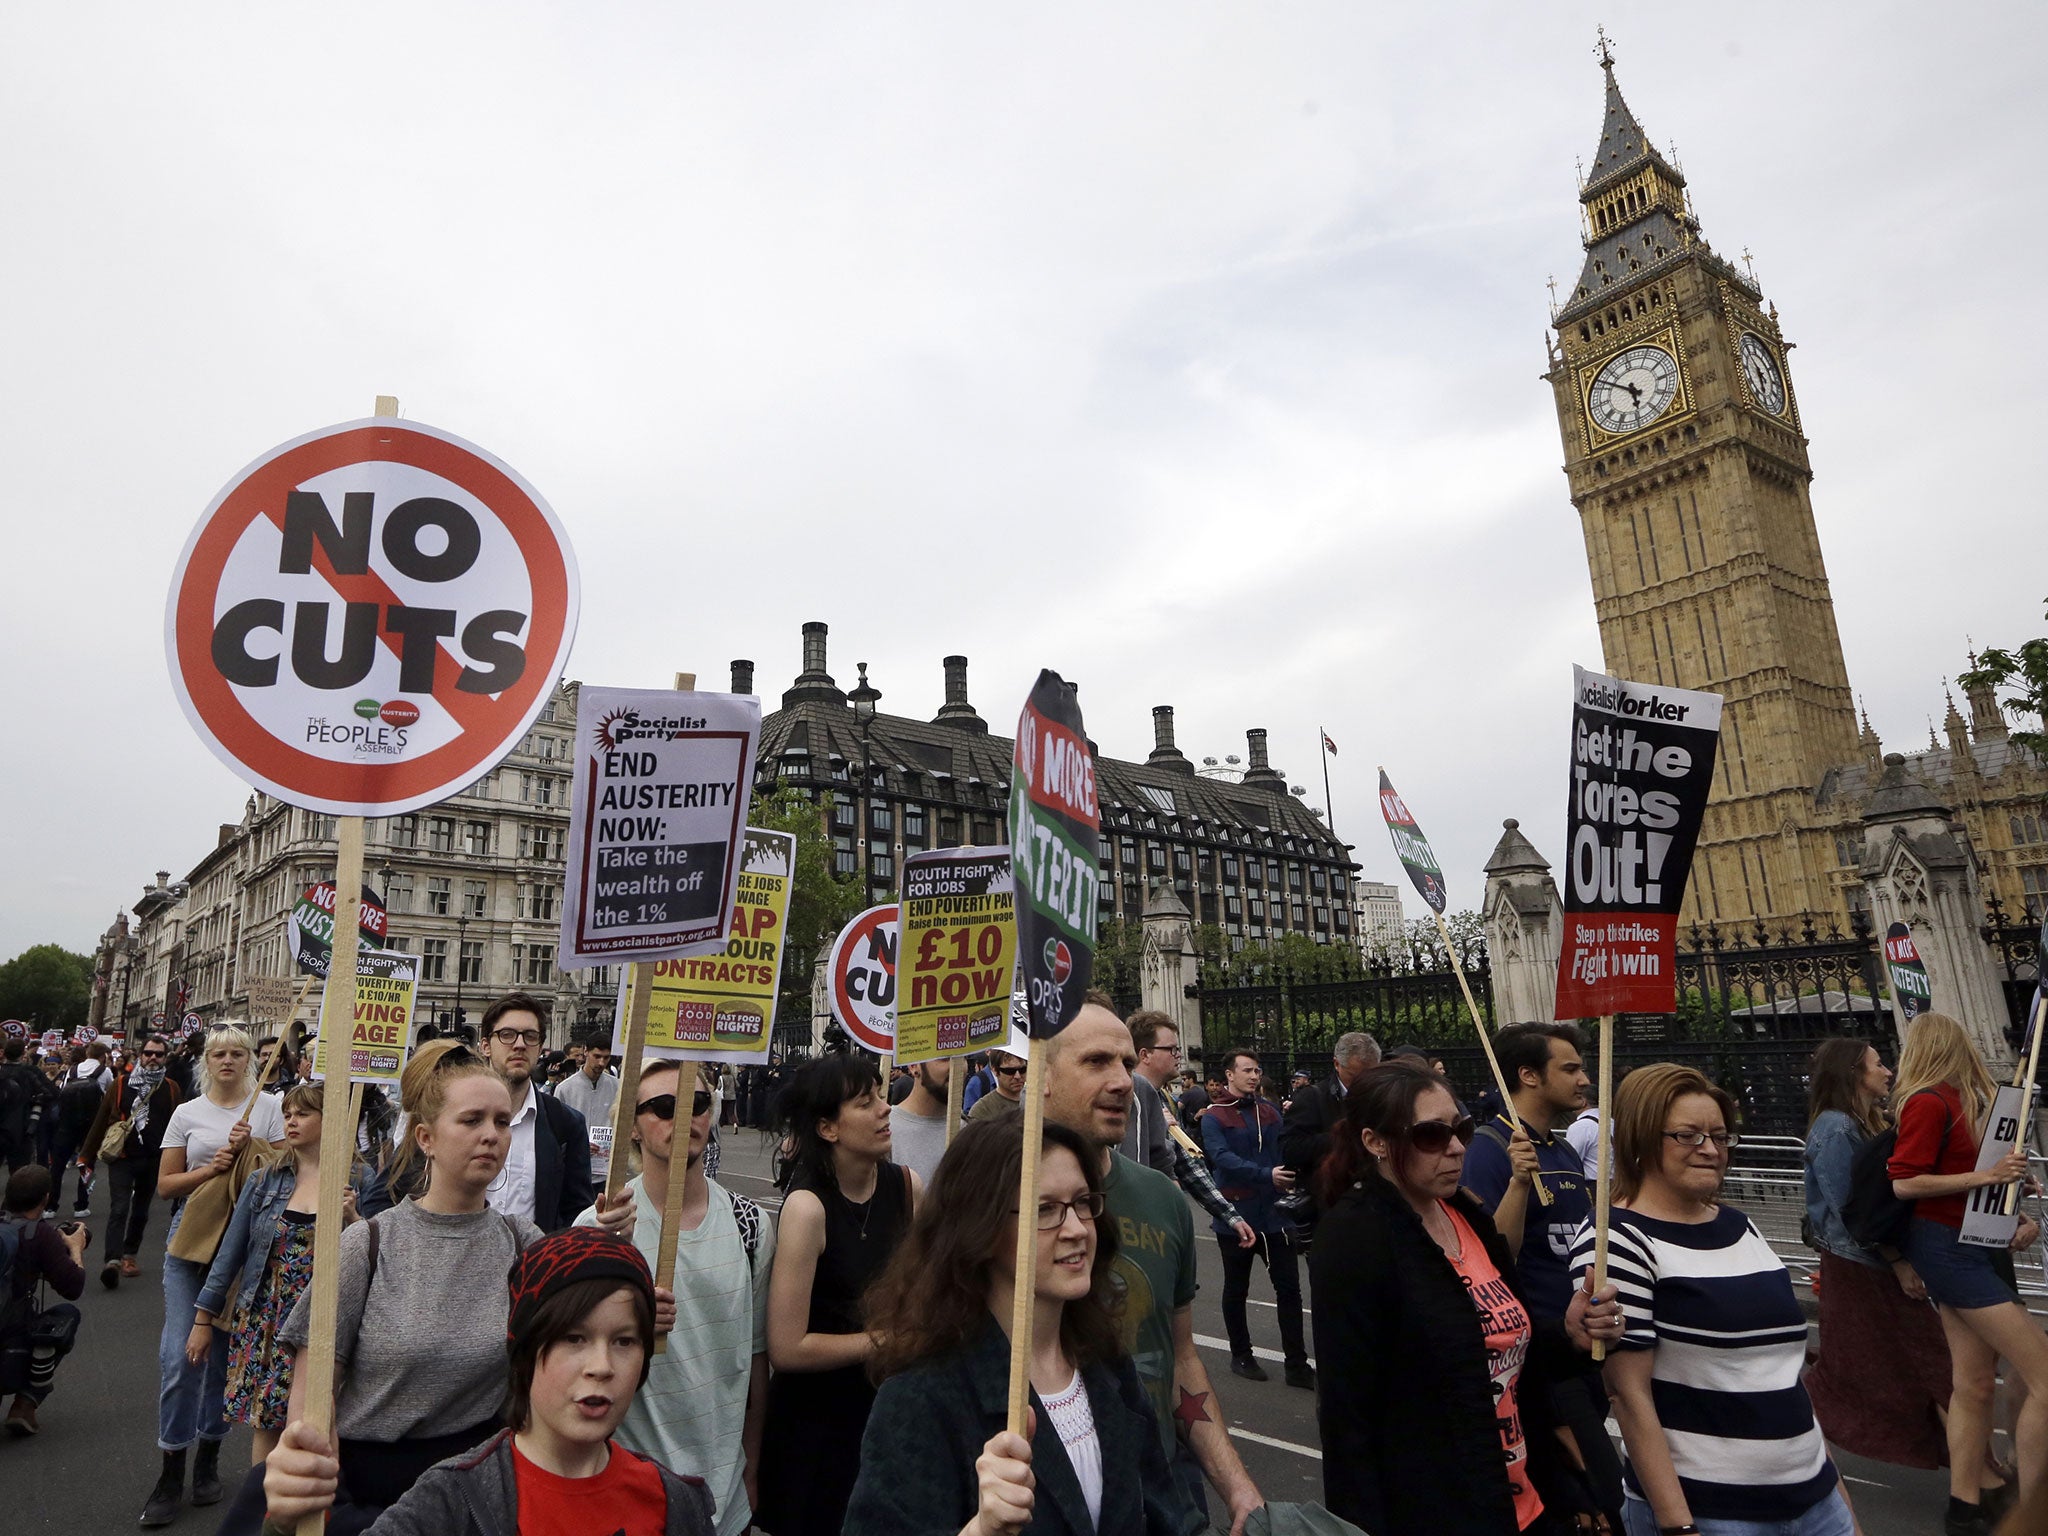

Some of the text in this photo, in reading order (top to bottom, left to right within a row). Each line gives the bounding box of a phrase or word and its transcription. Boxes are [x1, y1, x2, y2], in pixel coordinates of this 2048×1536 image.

[279, 491, 481, 583] NO
[211, 598, 527, 695] CUTS
[308, 717, 326, 726] THE
[622, 712, 707, 728] Socialist
[354, 744, 404, 755] ASSEMBLY
[1576, 717, 1692, 778] Get the
[604, 752, 657, 777] END
[1043, 731, 1094, 817] MORE
[600, 782, 735, 811] AUSTERITY
[1575, 764, 1681, 829] Tories
[598, 817, 666, 842] NOW:
[600, 845, 688, 868] Take the
[1573, 824, 1674, 905] Out!
[738, 875, 782, 892] RE JOBS
[908, 865, 988, 882] YOUTH FIGHT
[597, 871, 704, 897] wealth off
[908, 881, 966, 897] FOR JOBS
[312, 885, 385, 931] NO ORE
[737, 890, 770, 906] WAGE
[909, 892, 1014, 918] END POVERTY PAY
[595, 902, 667, 926] the 1%
[908, 911, 1014, 931] Raise the minimum wage
[582, 927, 718, 951] www.socialistparty.org.uk
[868, 926, 896, 963] N
[1575, 924, 1595, 946] Step
[1618, 923, 1660, 942] strikes
[725, 939, 776, 962] OUR
[915, 925, 1002, 972] £10
[356, 966, 374, 974] OBS
[366, 958, 392, 968] FIGHT
[1622, 946, 1659, 976] win
[243, 976, 292, 988] WHAT IDIOT
[653, 959, 773, 985] ONTRACTS
[358, 990, 401, 1003] A £10/HR
[394, 981, 411, 992] PAY
[844, 966, 895, 1007] CU
[911, 967, 1004, 1008] now
[255, 995, 291, 1004] CAMERON
[679, 1002, 713, 1011] BAKERS
[354, 1002, 406, 1024] VING
[678, 1010, 713, 1020] FOOD
[716, 1013, 761, 1023] FAST FOOD
[677, 1024, 711, 1032] WORKERS
[716, 1021, 760, 1033] RIGHTS
[938, 1022, 967, 1031] FOOD
[970, 1019, 985, 1028] FAST
[970, 1021, 1000, 1036] RIGHTS
[352, 1024, 399, 1044] AGE
[676, 1031, 710, 1041] UNION
[937, 1040, 966, 1050] UNION
[371, 1061, 397, 1069] RIGHTS
[1118, 1216, 1166, 1257] BAY
[1961, 1234, 1985, 1244] NATIONAL
